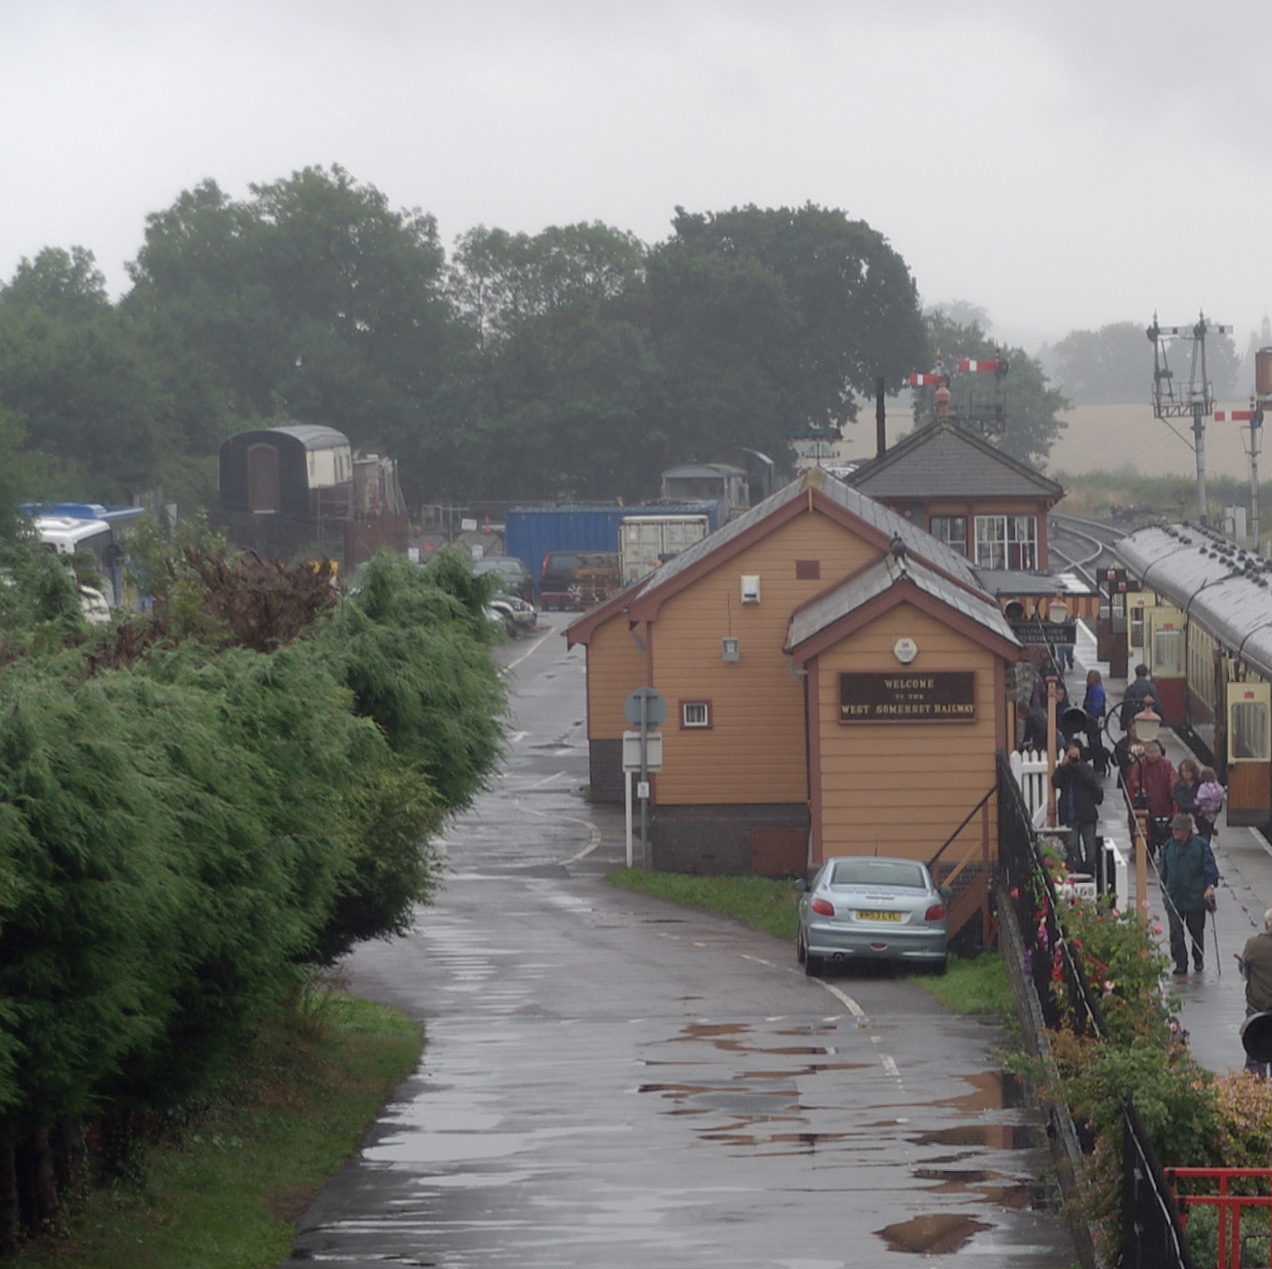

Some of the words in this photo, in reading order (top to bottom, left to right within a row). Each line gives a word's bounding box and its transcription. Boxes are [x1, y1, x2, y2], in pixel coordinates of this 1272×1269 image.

[884, 678, 935, 689] WELCOME
[841, 704, 870, 715] WEST
[876, 704, 931, 715] SOMERSET
[934, 703, 975, 714] RAILWAY
